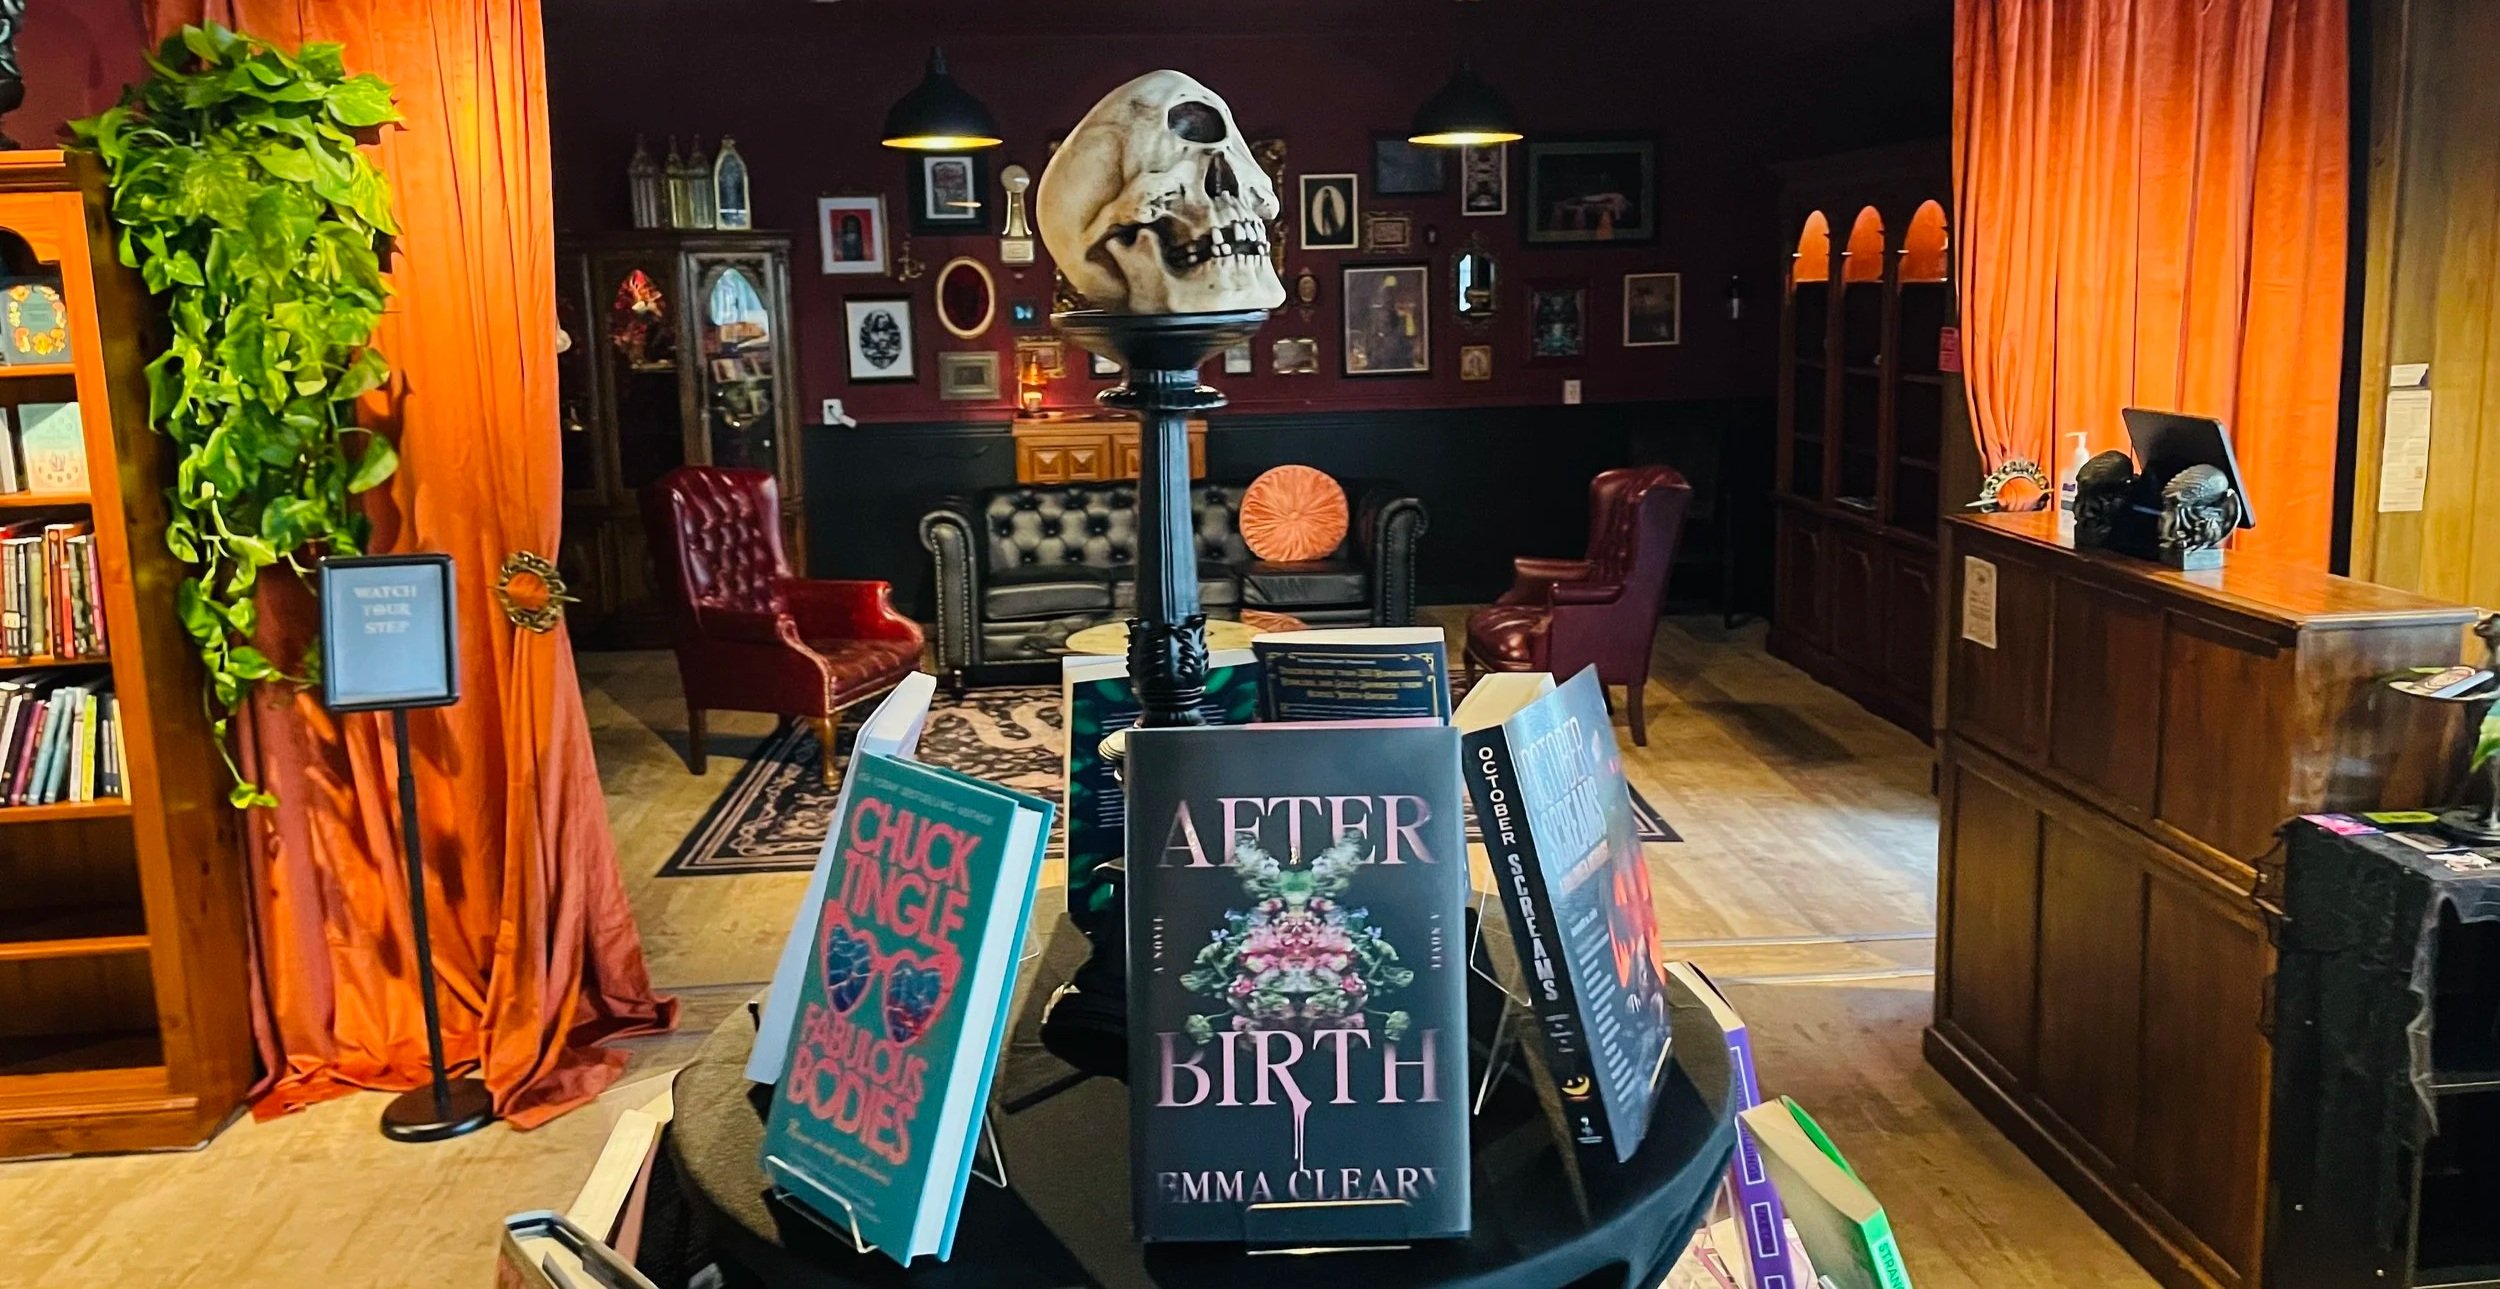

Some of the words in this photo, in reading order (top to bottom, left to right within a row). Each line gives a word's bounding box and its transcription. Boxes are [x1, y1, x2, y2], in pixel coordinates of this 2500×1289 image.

[354, 585, 417, 598] WATCH
[362, 603, 412, 616] YOUR
[365, 621, 410, 634] STEP
[1520, 715, 1593, 812] OCTOBER
[852, 797, 982, 893] CHUCK
[1155, 795, 1440, 868] AFTER
[1540, 775, 1608, 875] SCREAMS
[840, 848, 970, 952] TINGLE
[1478, 746, 1516, 846] OCTOBER
[1507, 853, 1559, 1001] SCREAMS
[802, 1002, 929, 1104] FABULOUS
[1154, 1029, 1444, 1108] BIRTH
[786, 1043, 916, 1166] BODIES
[1155, 1170, 1274, 1203] EMMA
[1287, 1166, 1447, 1201] CLEARY
[1878, 1242, 1905, 1289] STRAN
